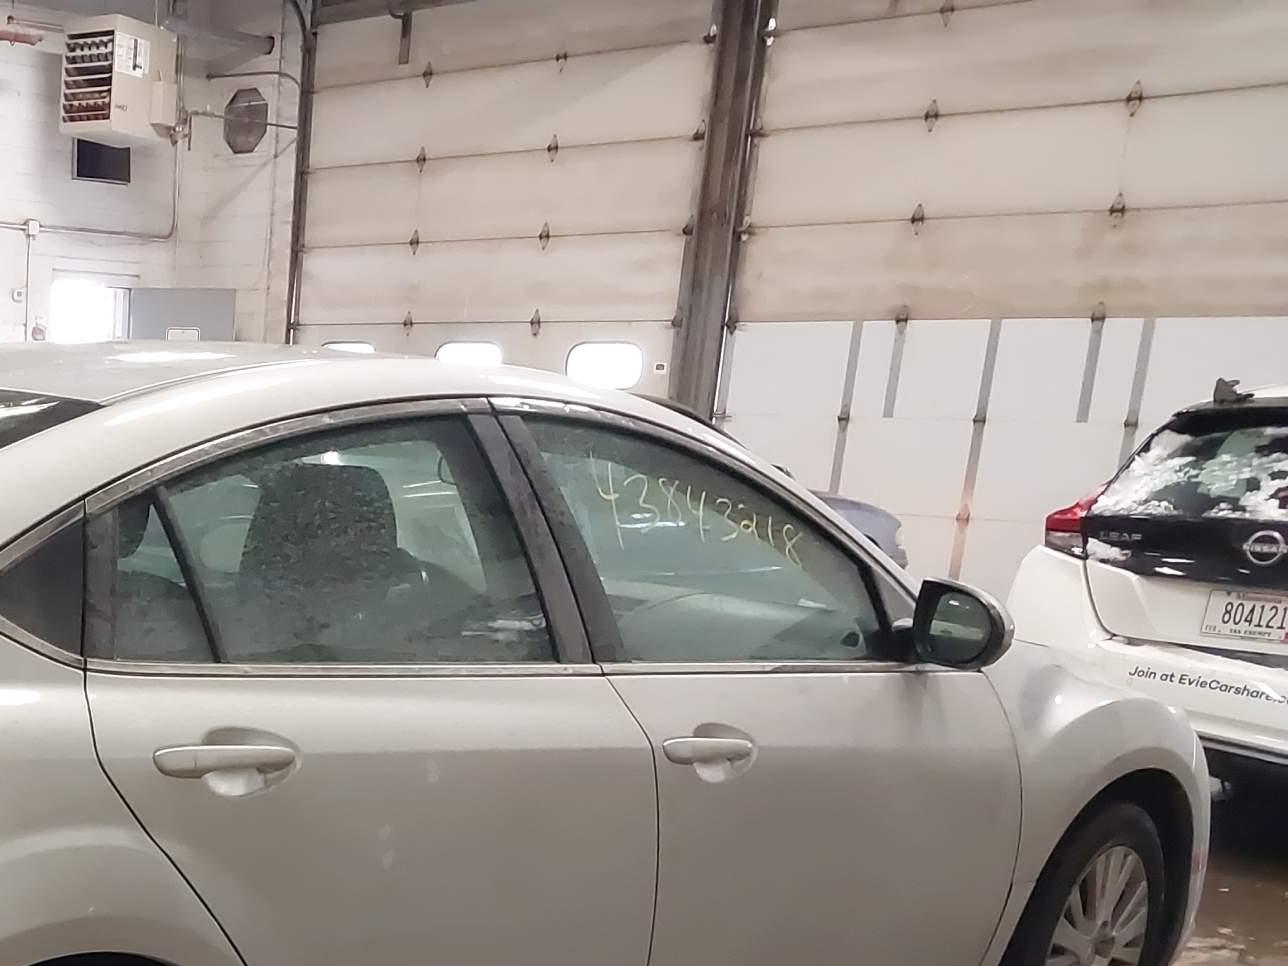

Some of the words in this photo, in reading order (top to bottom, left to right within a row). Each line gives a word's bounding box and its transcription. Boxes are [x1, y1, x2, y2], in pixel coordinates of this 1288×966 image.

[1221, 602, 1288, 630] 804121
[1128, 666, 1157, 681] Join
[1159, 671, 1176, 683] at
